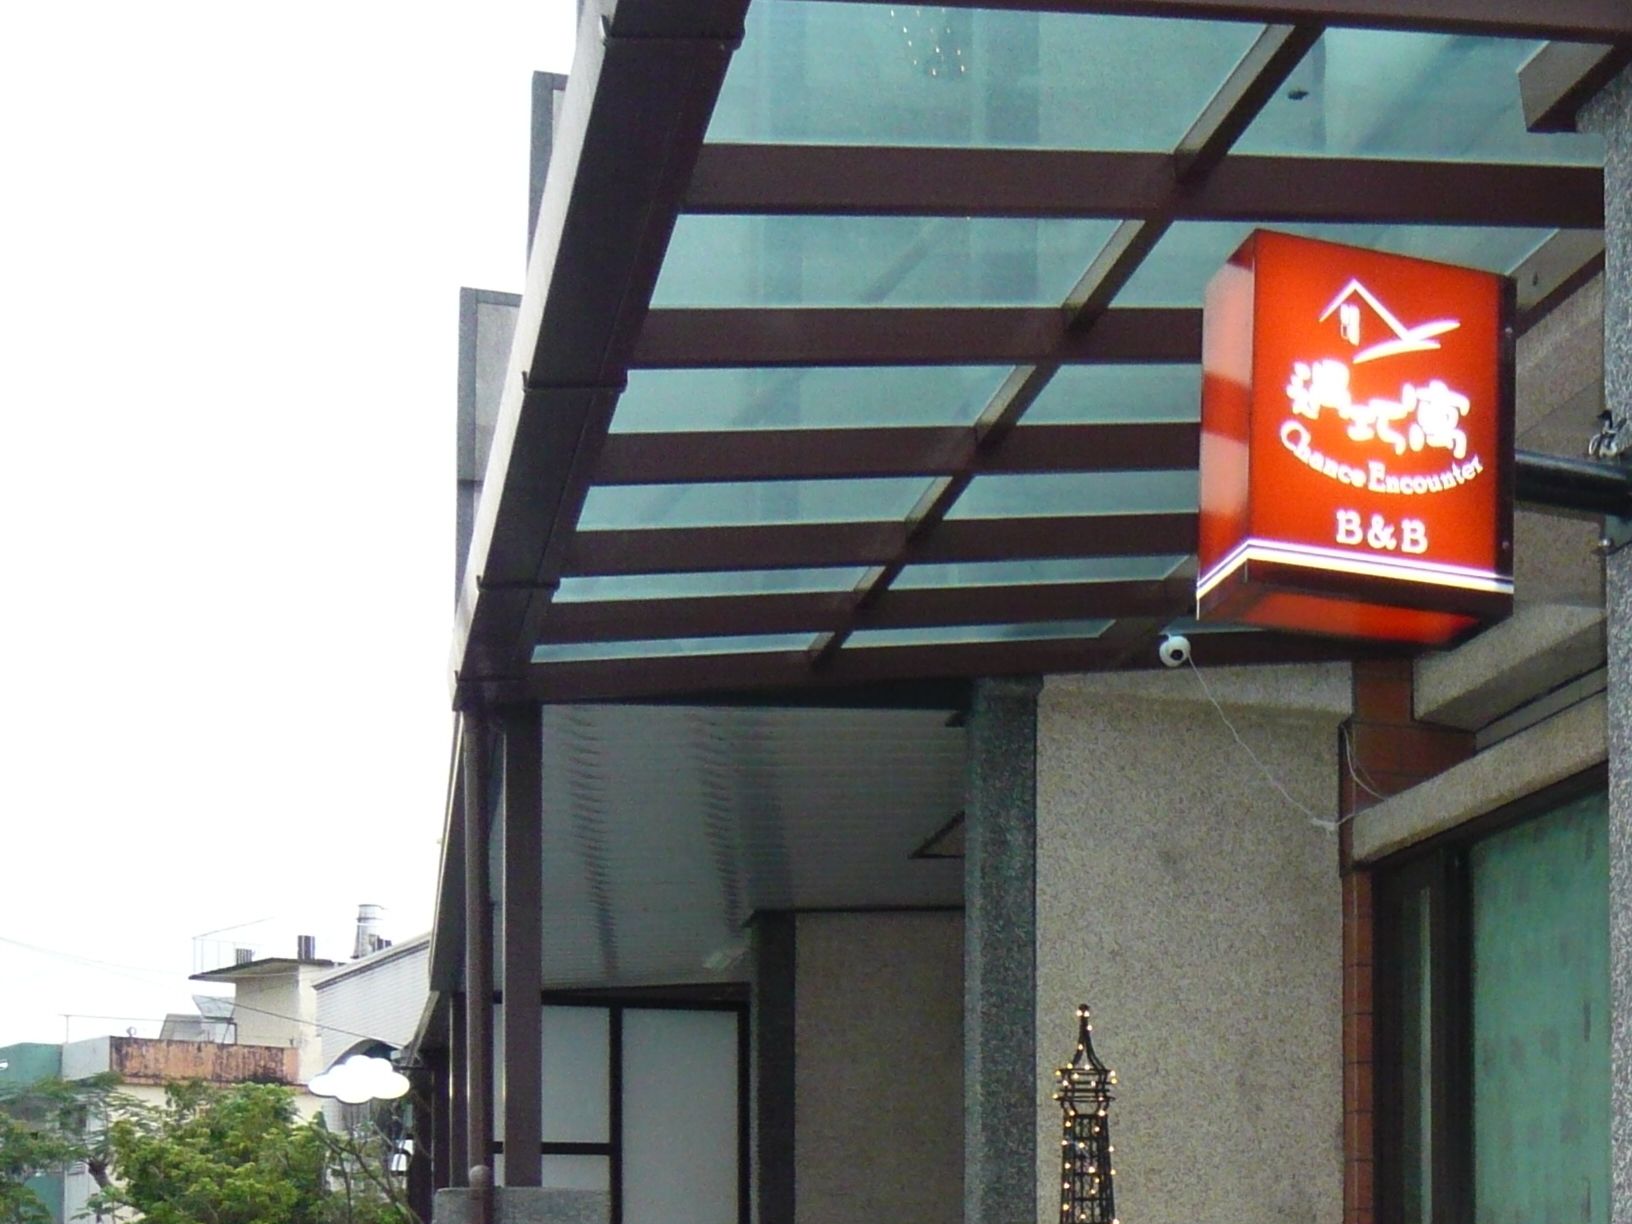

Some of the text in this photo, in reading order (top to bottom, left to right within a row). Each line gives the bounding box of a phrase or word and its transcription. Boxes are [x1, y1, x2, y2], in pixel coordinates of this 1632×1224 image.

[1280, 420, 1484, 495] Chance Encounter
[1335, 508, 1429, 555] B&B
